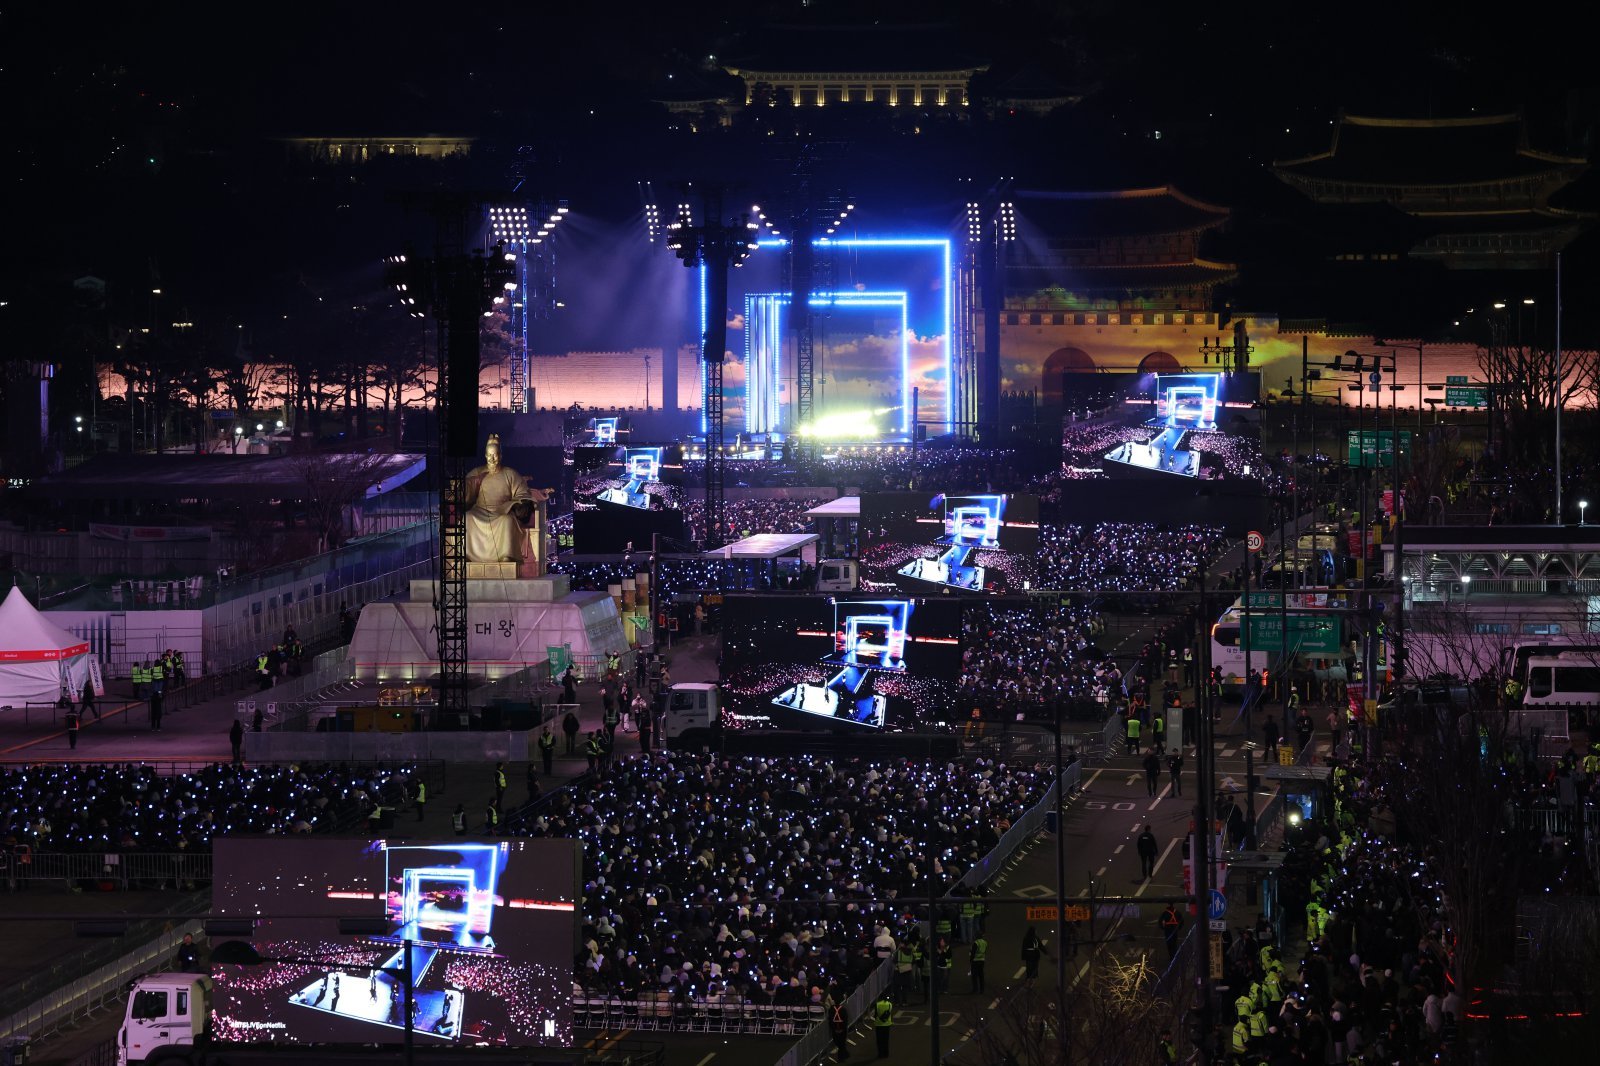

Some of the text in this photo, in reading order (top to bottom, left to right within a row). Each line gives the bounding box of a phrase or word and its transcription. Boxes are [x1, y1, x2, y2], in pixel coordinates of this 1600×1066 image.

[1248, 537, 1259, 546] 50
[1084, 801, 1136, 811] 50
[544, 1019, 555, 1037] N
